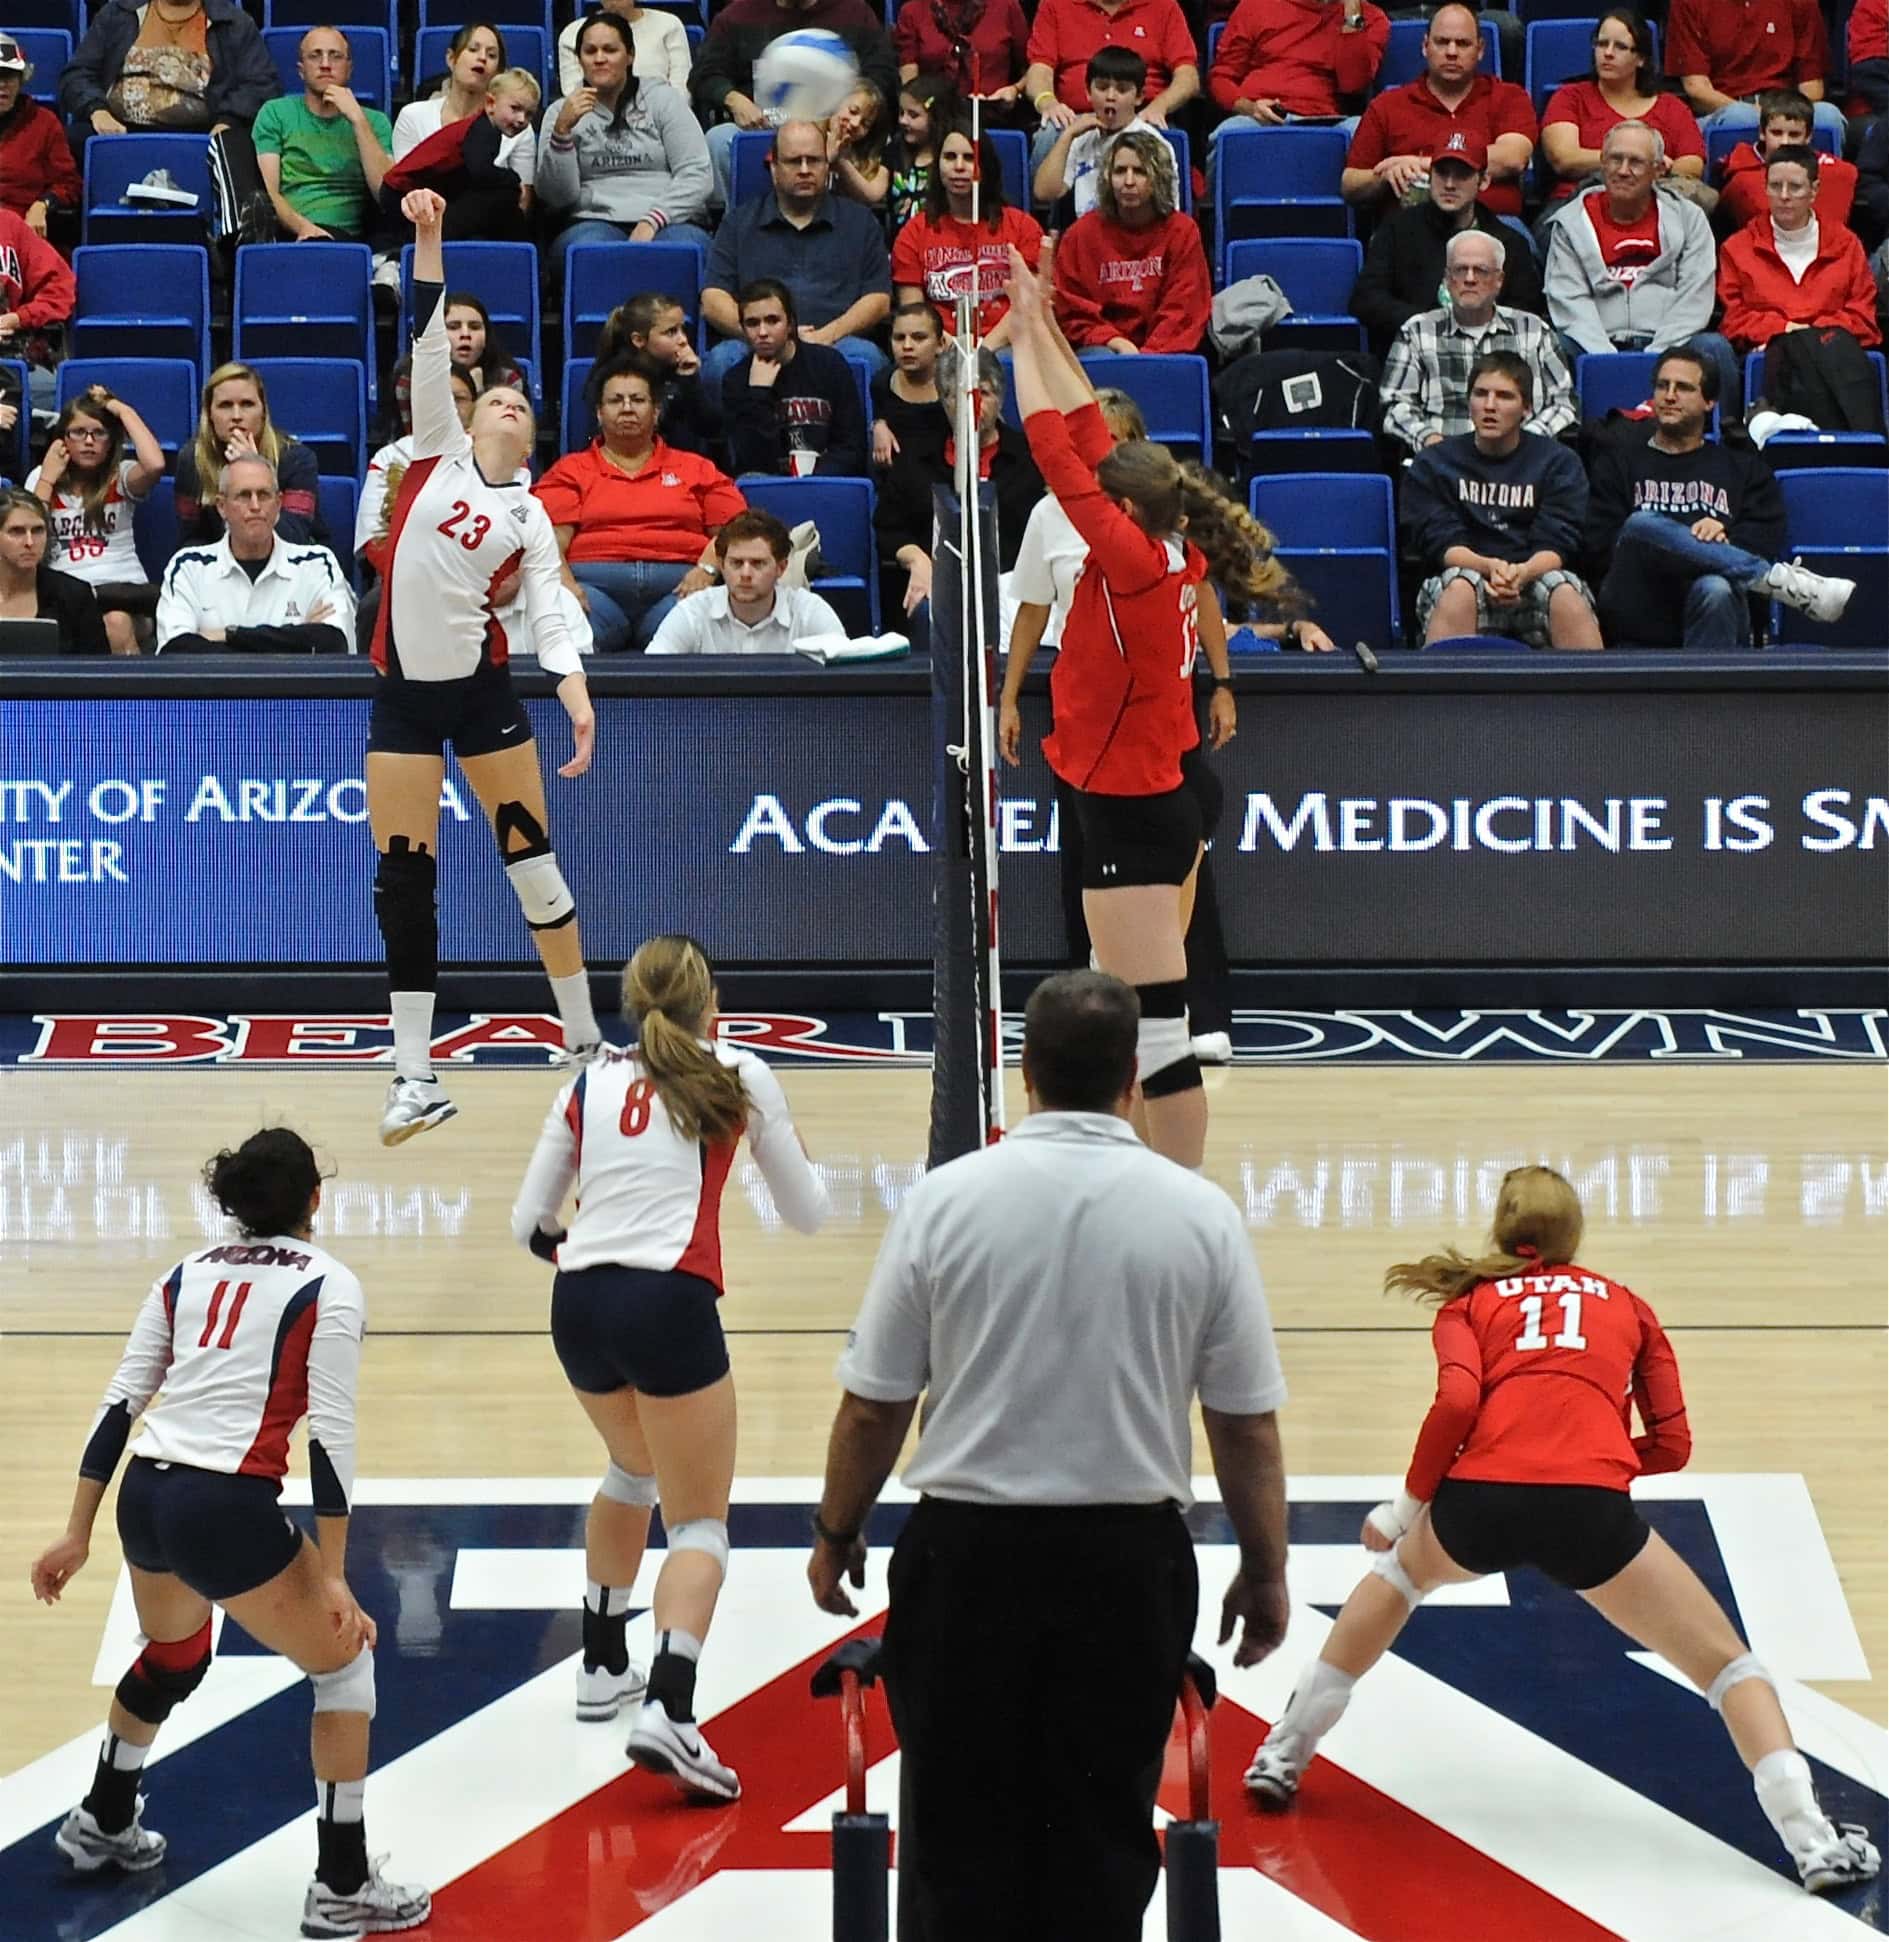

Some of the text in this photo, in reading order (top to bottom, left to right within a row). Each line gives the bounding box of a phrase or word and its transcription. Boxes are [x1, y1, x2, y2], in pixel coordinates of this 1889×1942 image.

[0, 244, 23, 290] A
[1098, 255, 1164, 285] ARIZON
[1458, 477, 1536, 508] ARIZONA
[1634, 479, 1731, 517] ARIZONA
[436, 499, 492, 551] 23
[89, 780, 165, 823] OF
[184, 775, 471, 823] ARIZOA
[1238, 792, 1674, 853] MEDICINE
[1703, 794, 1775, 853] IS
[618, 1076, 657, 1138] 8
[1494, 1274, 1609, 1300] UTAH
[197, 1280, 253, 1350] 11
[1514, 1291, 1587, 1351] 11
